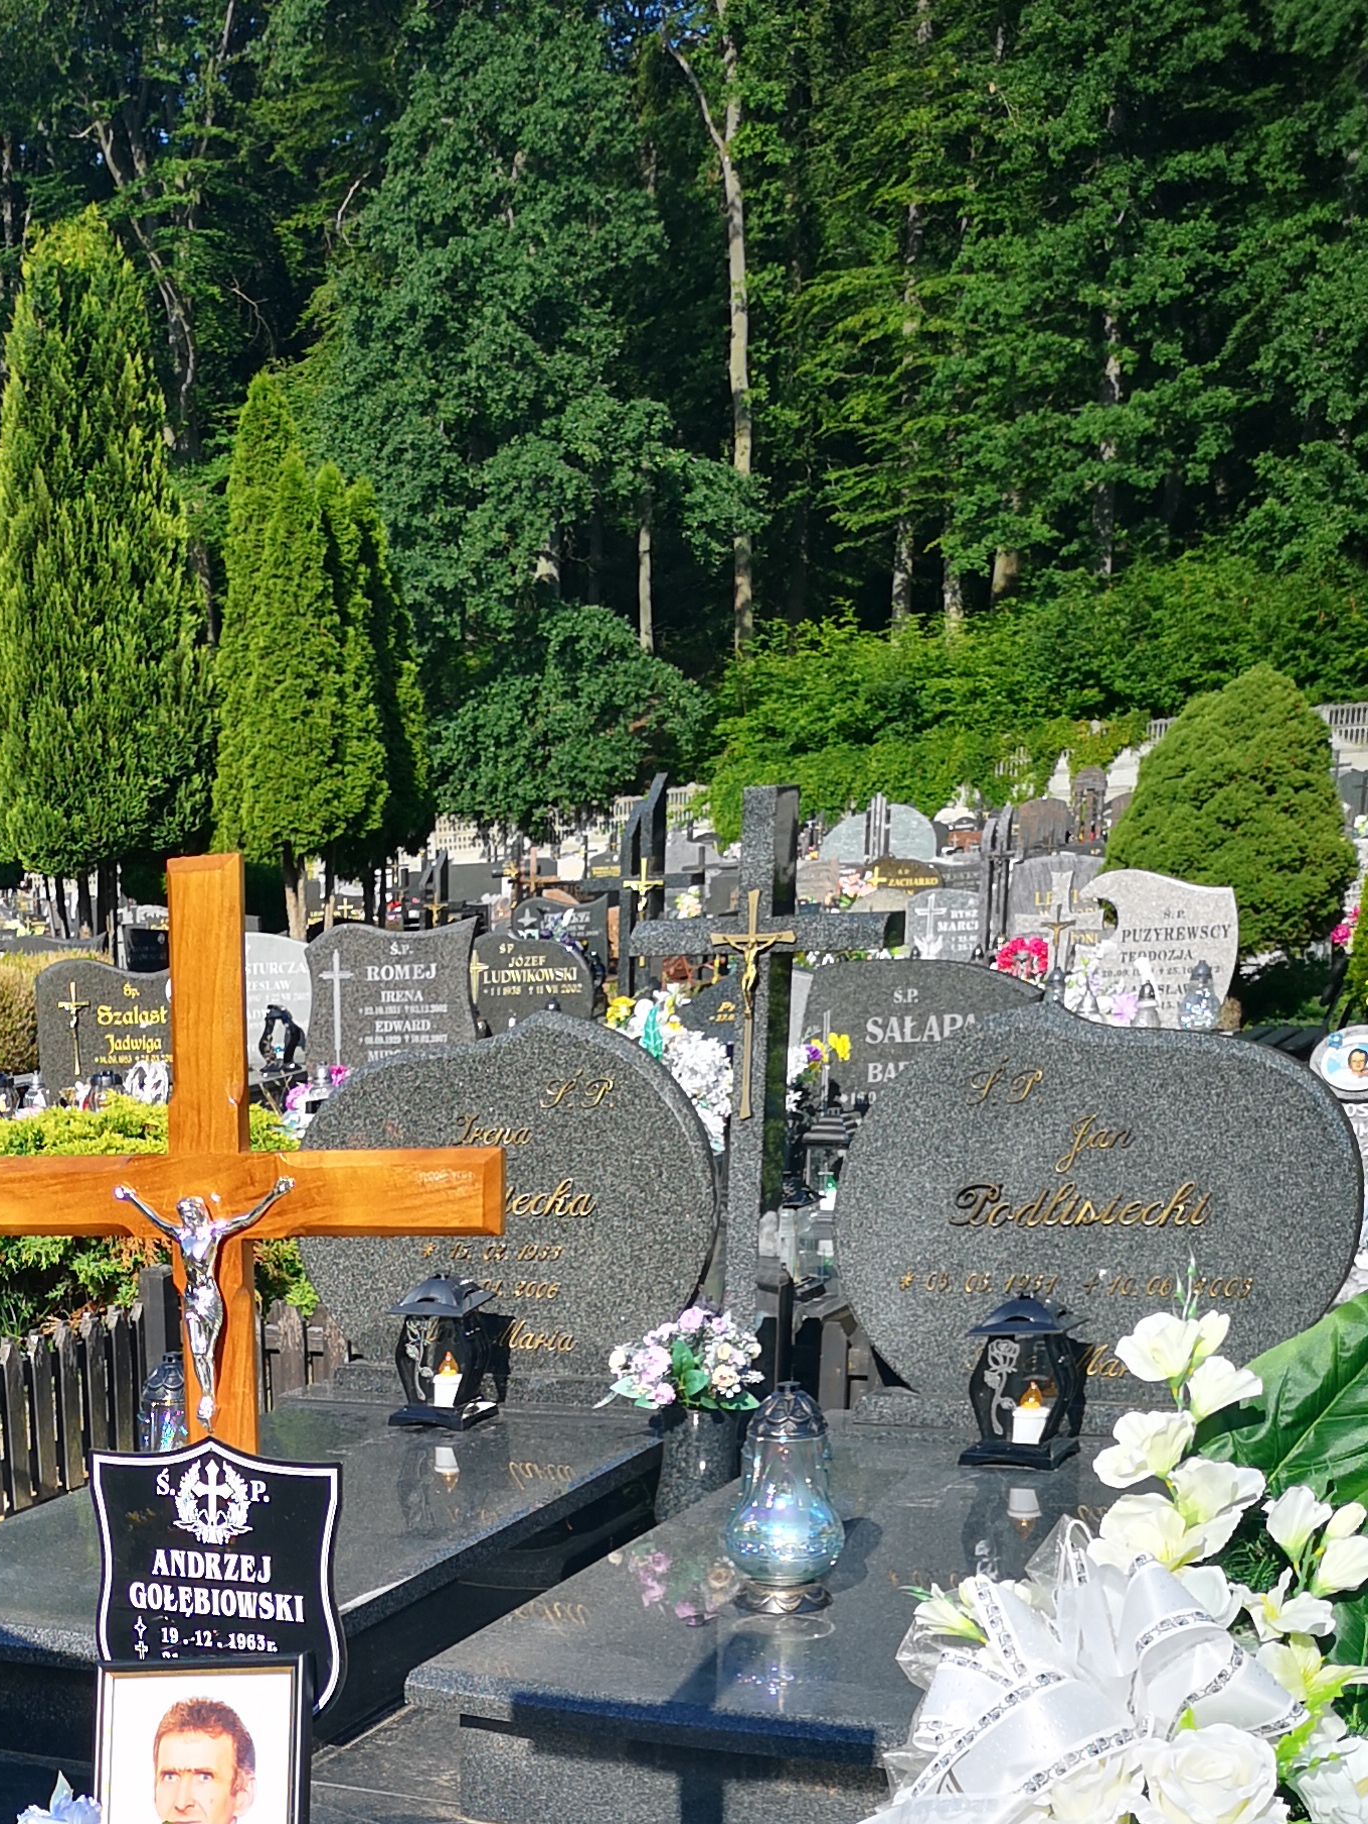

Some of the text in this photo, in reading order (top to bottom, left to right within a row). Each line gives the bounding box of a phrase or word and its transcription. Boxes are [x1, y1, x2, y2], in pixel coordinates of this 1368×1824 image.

[1122, 924, 1232, 943] PUZYREWSCY
[508, 955, 547, 968] JÓZEF
[366, 963, 438, 982] ROMEJ
[483, 966, 578, 985] LUDWIKOWSKI
[380, 990, 424, 1003] IRENA
[375, 1019, 431, 1033] EDWARD
[1055, 1114, 1134, 1174] Jan
[948, 1181, 1213, 1228] Podlisiecki
[151, 1548, 272, 1584] ANDRZEJ
[129, 1581, 306, 1623] GOŁĘBIOWSKI
